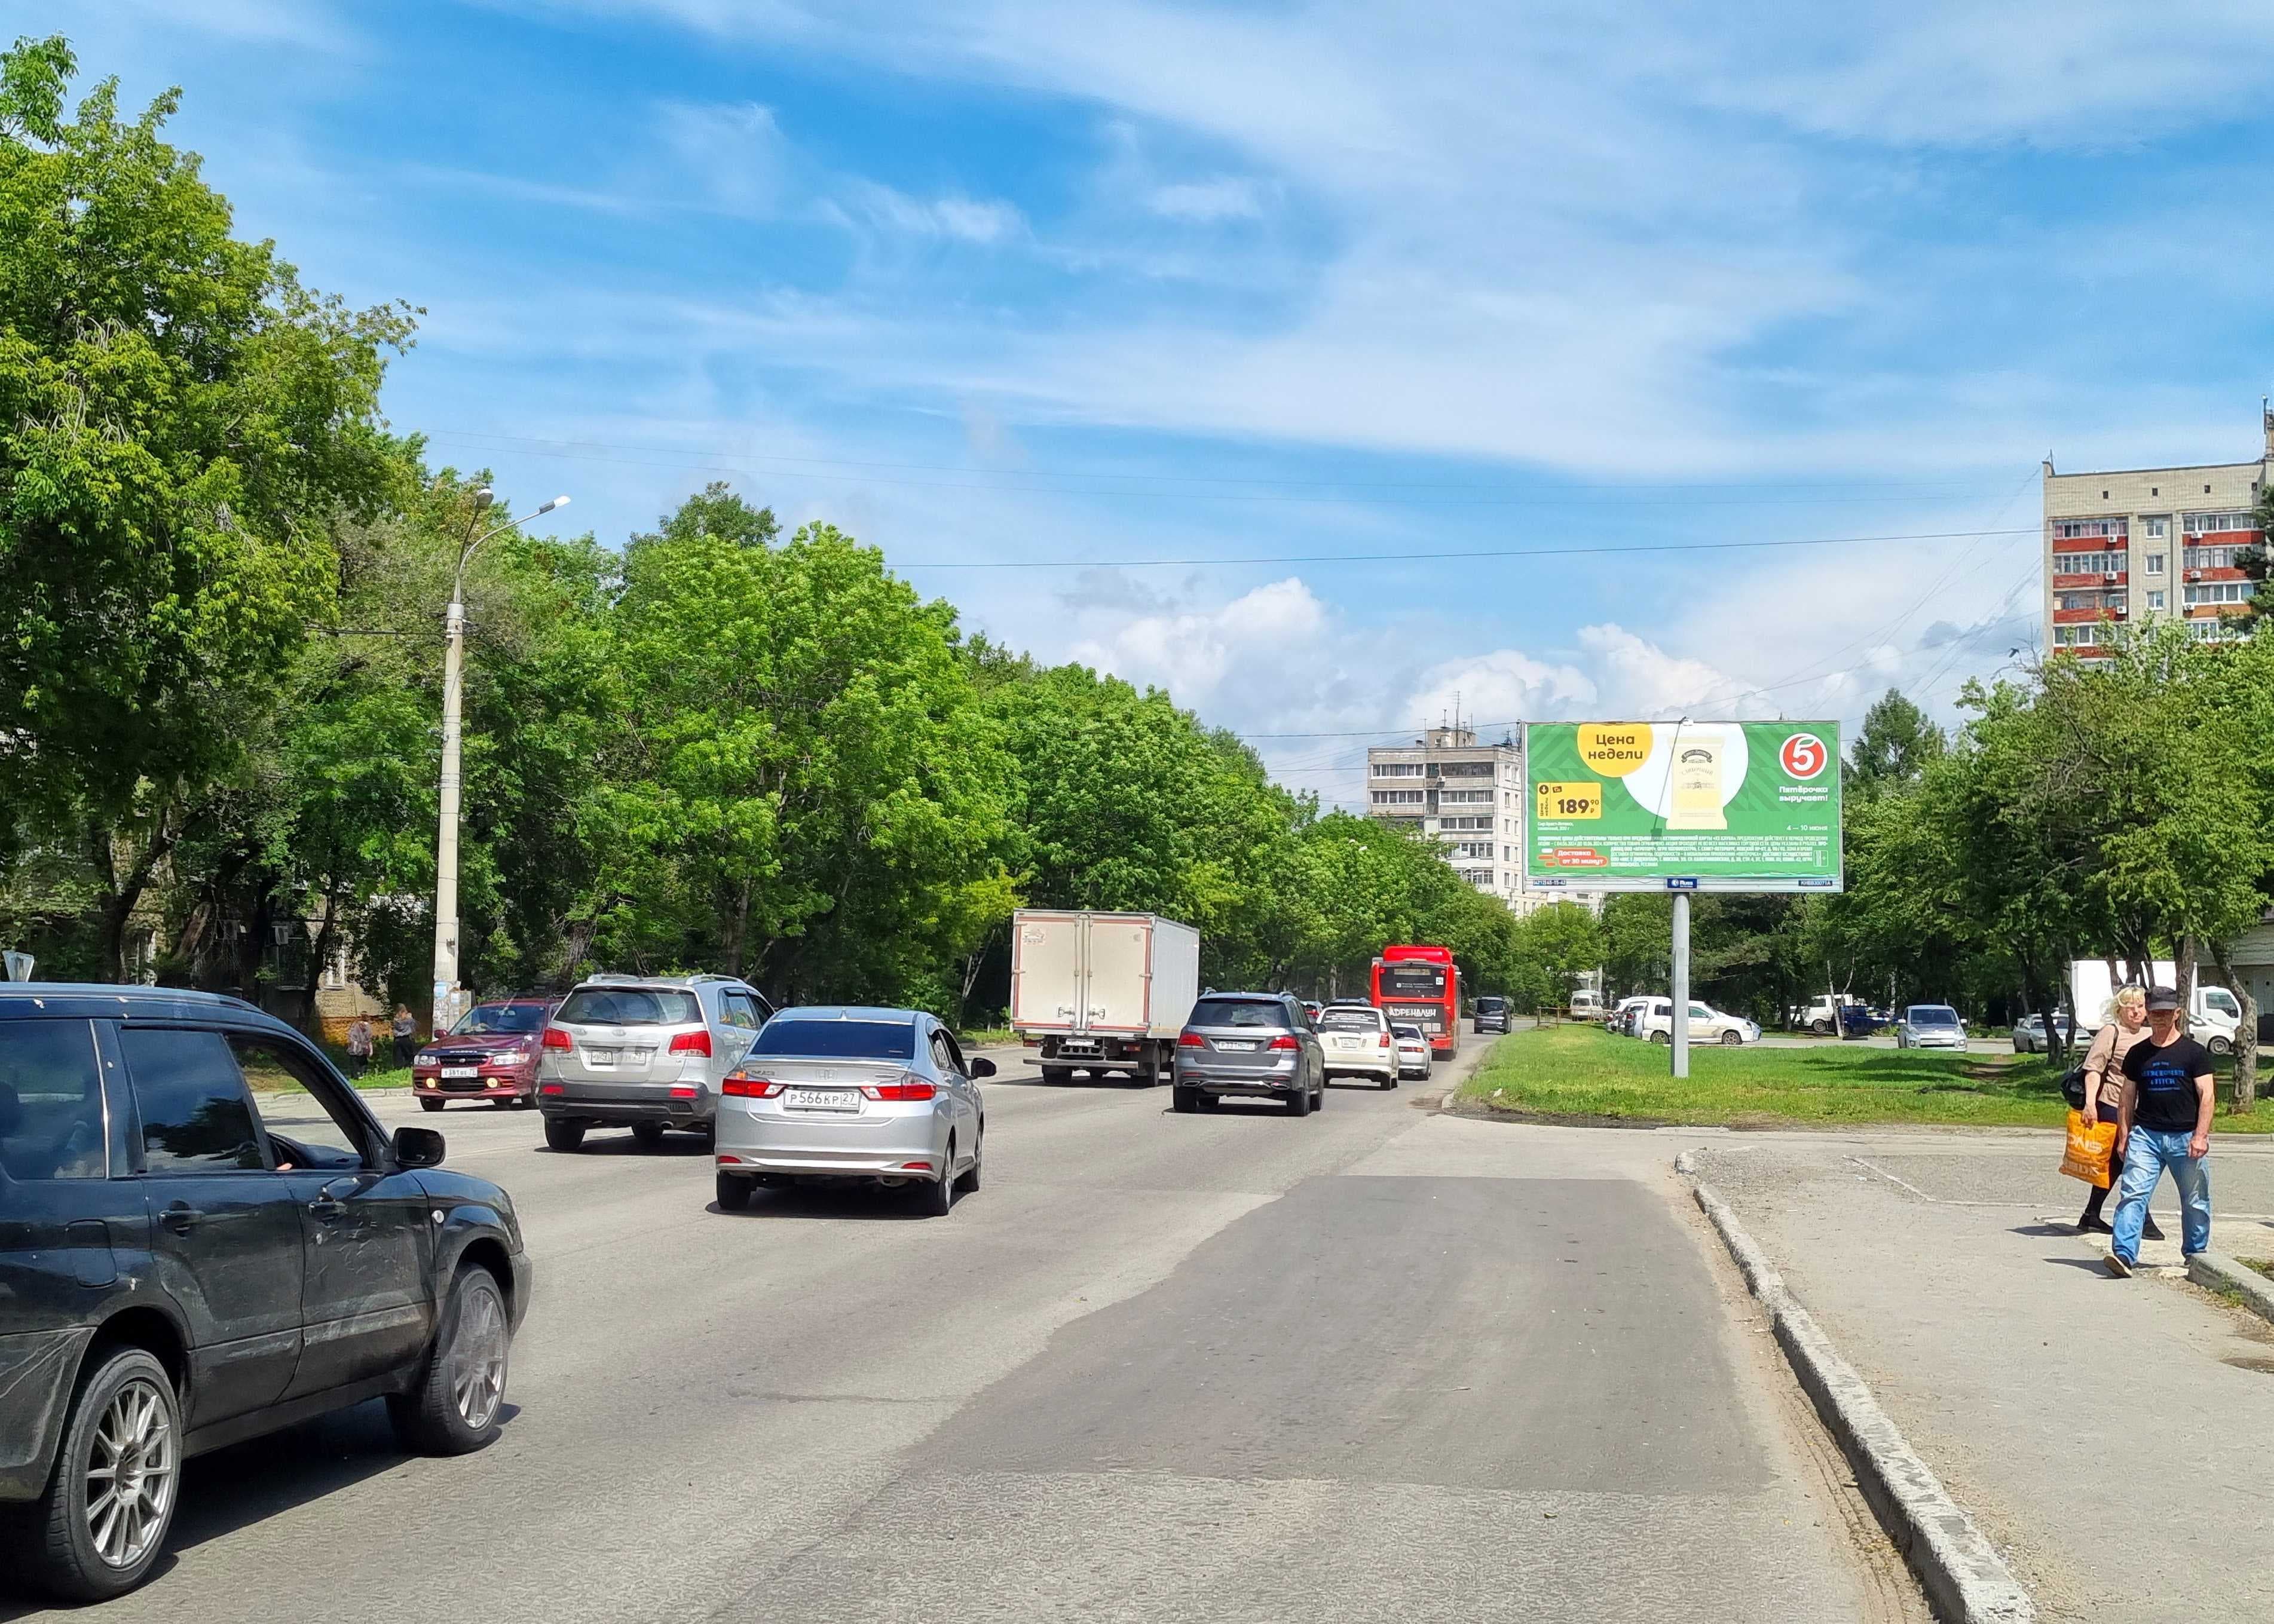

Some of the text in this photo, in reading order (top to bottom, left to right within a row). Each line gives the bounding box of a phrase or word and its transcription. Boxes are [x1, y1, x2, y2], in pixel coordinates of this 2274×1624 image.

[1596, 734, 1635, 746] Цена
[1588, 748, 1643, 759] недели
[1792, 736, 1817, 771] 5
[1779, 785, 1828, 793] Пятёрочка
[1779, 795, 1828, 803] выручает!
[1557, 799, 1590, 814] 189
